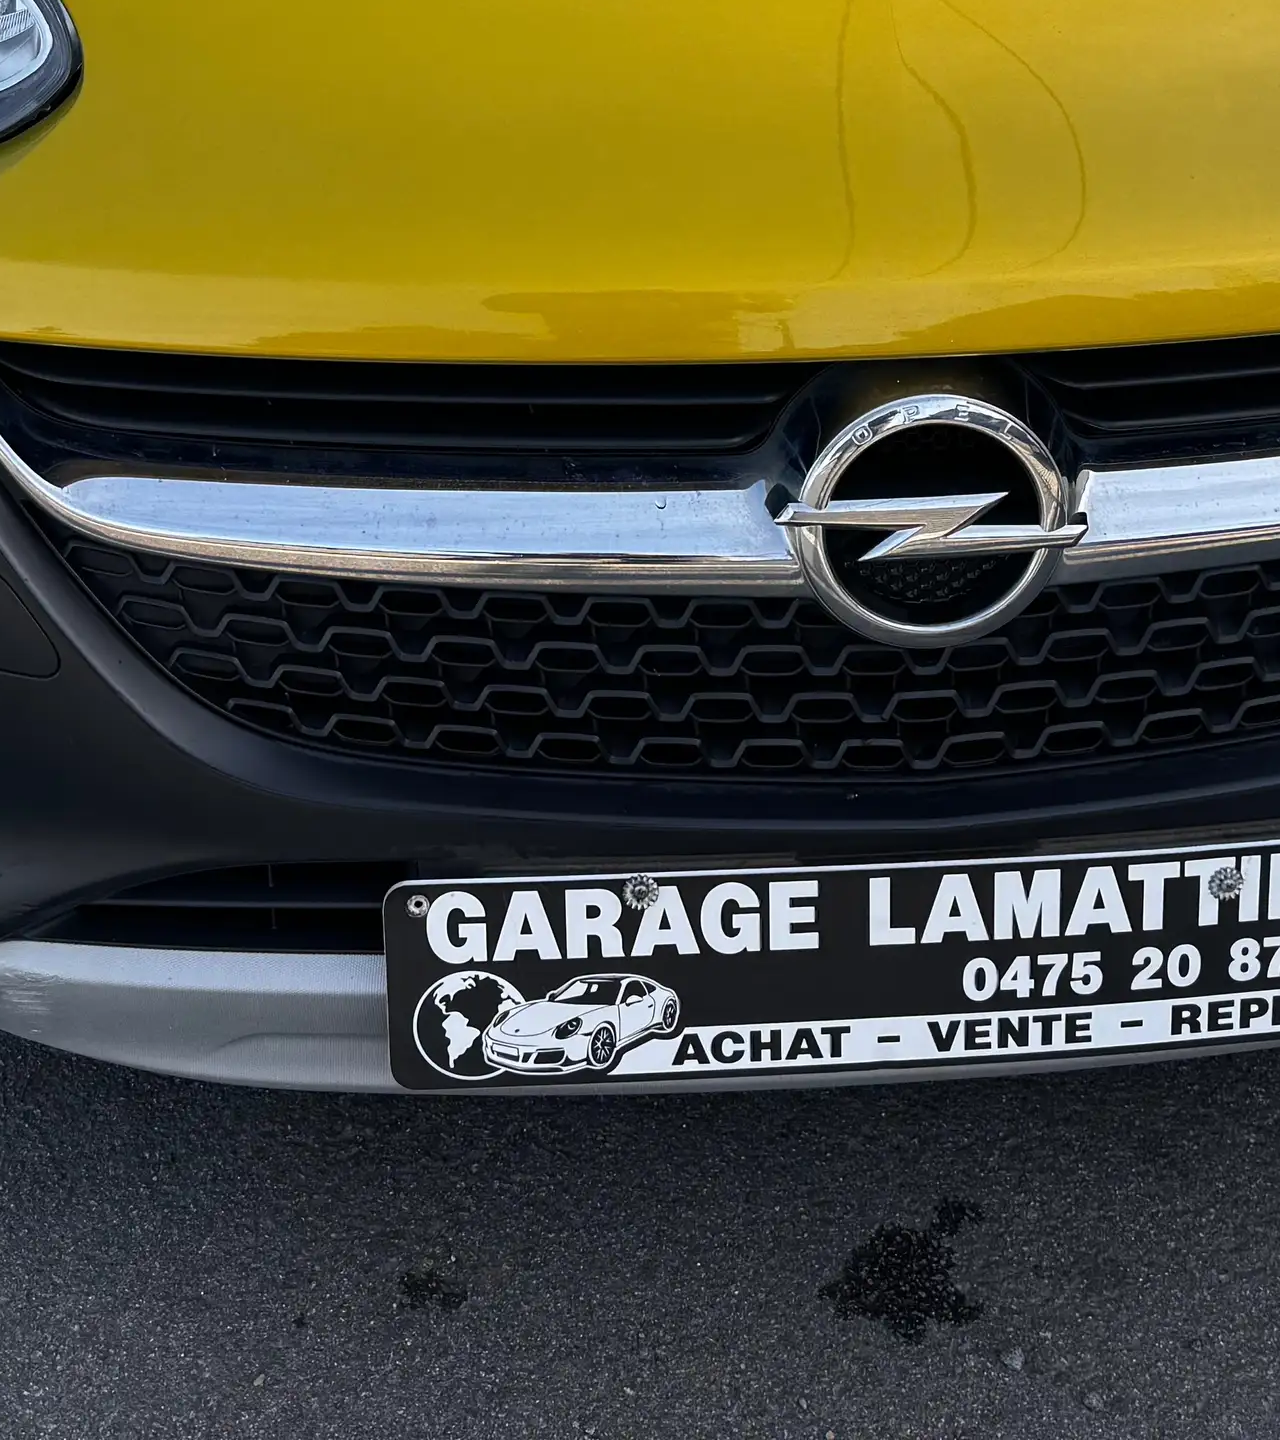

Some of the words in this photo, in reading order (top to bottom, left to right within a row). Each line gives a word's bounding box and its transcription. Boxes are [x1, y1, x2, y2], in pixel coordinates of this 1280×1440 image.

[851, 403, 1016, 447] OPEL
[426, 881, 821, 965] GARAGE
[962, 951, 1103, 1002] 0475
[1130, 943, 1202, 991] 20
[671, 1025, 851, 1067] ACHAT
[926, 1011, 1093, 1053] VENTE
